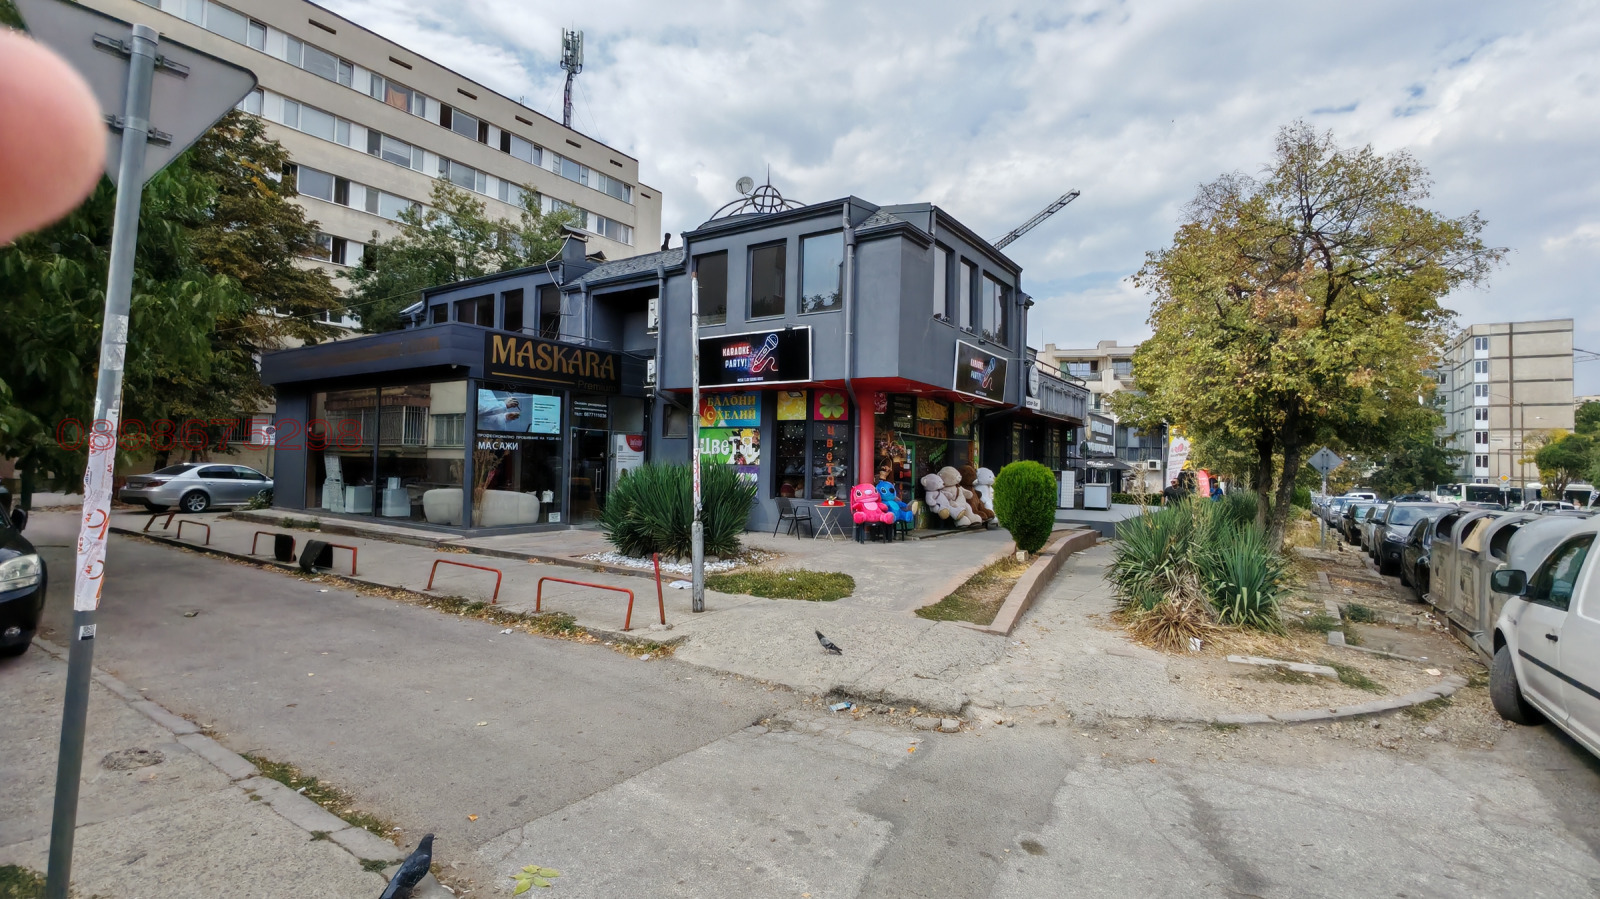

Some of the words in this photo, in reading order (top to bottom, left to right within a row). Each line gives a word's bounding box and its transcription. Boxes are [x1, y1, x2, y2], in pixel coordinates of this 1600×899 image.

[722, 346, 749, 357] KARAOKE
[491, 335, 615, 380] MASKARA
[724, 358, 747, 369] PARTY!
[707, 395, 756, 406] БАЛОНИ
[717, 408, 756, 420] ХЕЛИЙ
[477, 441, 519, 451] МАСАЖИ
